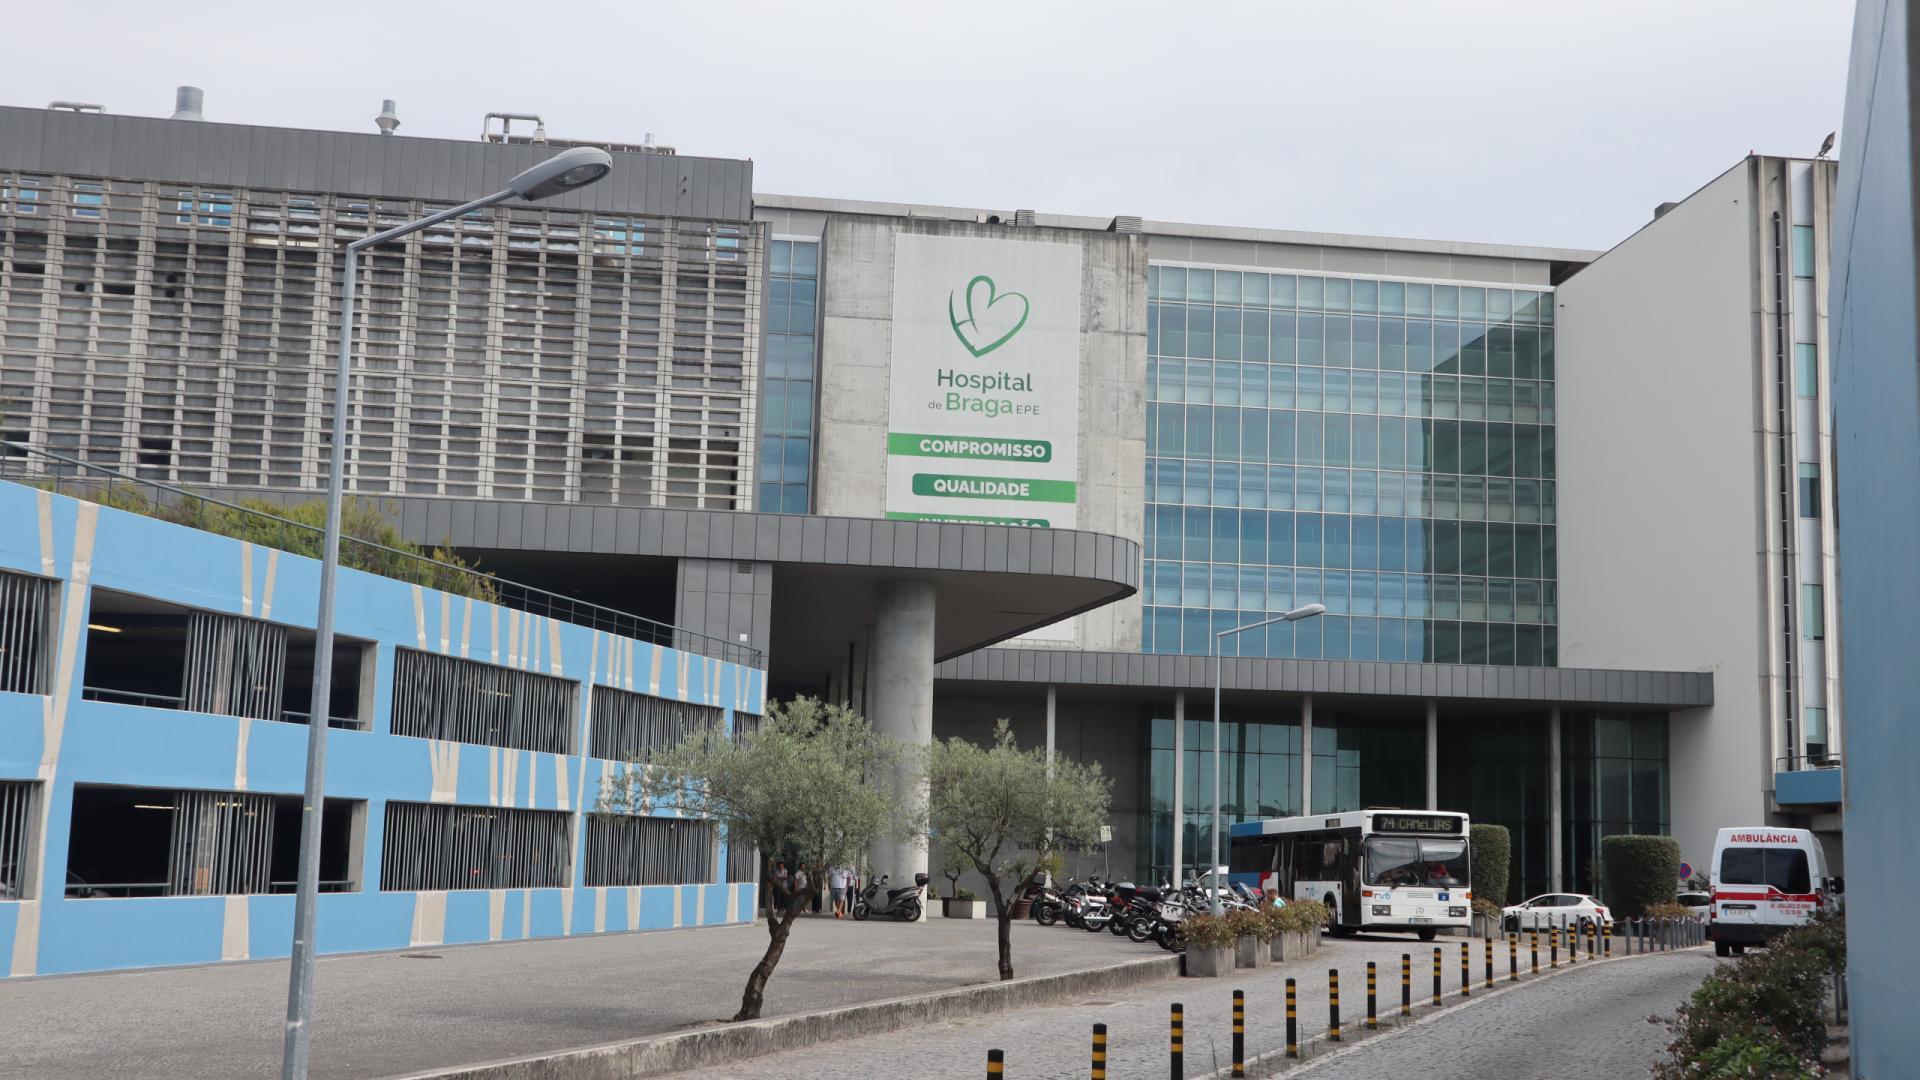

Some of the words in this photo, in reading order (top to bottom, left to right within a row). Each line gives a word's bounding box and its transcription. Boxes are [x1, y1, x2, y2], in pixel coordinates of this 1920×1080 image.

[937, 369, 1033, 393] Hospital
[928, 400, 942, 410] de
[945, 392, 1013, 418] Braga
[1016, 405, 1040, 416] EPE
[920, 439, 1046, 458] COMPROMISSO
[934, 479, 1030, 497] QUALIDADE
[1381, 818, 1395, 829] 74
